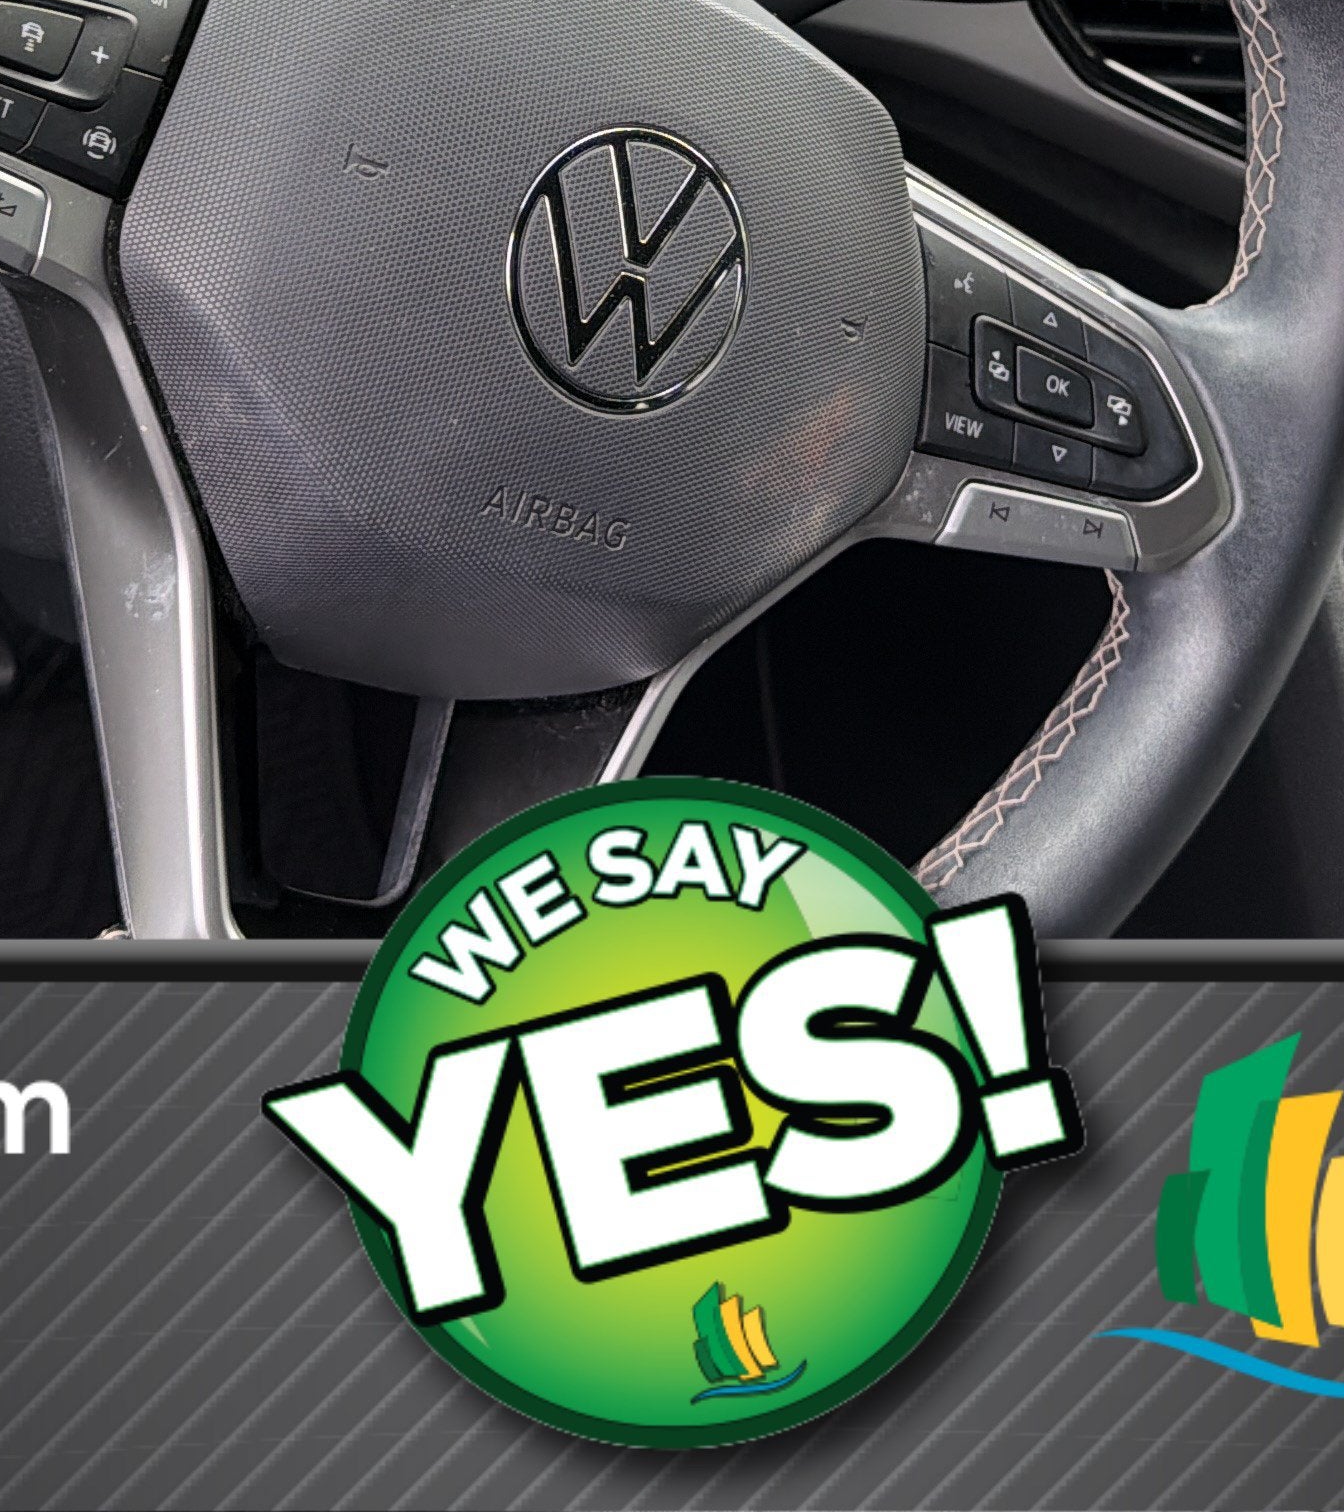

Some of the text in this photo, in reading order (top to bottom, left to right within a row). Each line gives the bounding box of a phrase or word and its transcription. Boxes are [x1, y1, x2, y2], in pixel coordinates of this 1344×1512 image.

[1046, 374, 1070, 398] OK
[945, 411, 983, 439] VIEW
[481, 486, 631, 551] AIRBAG
